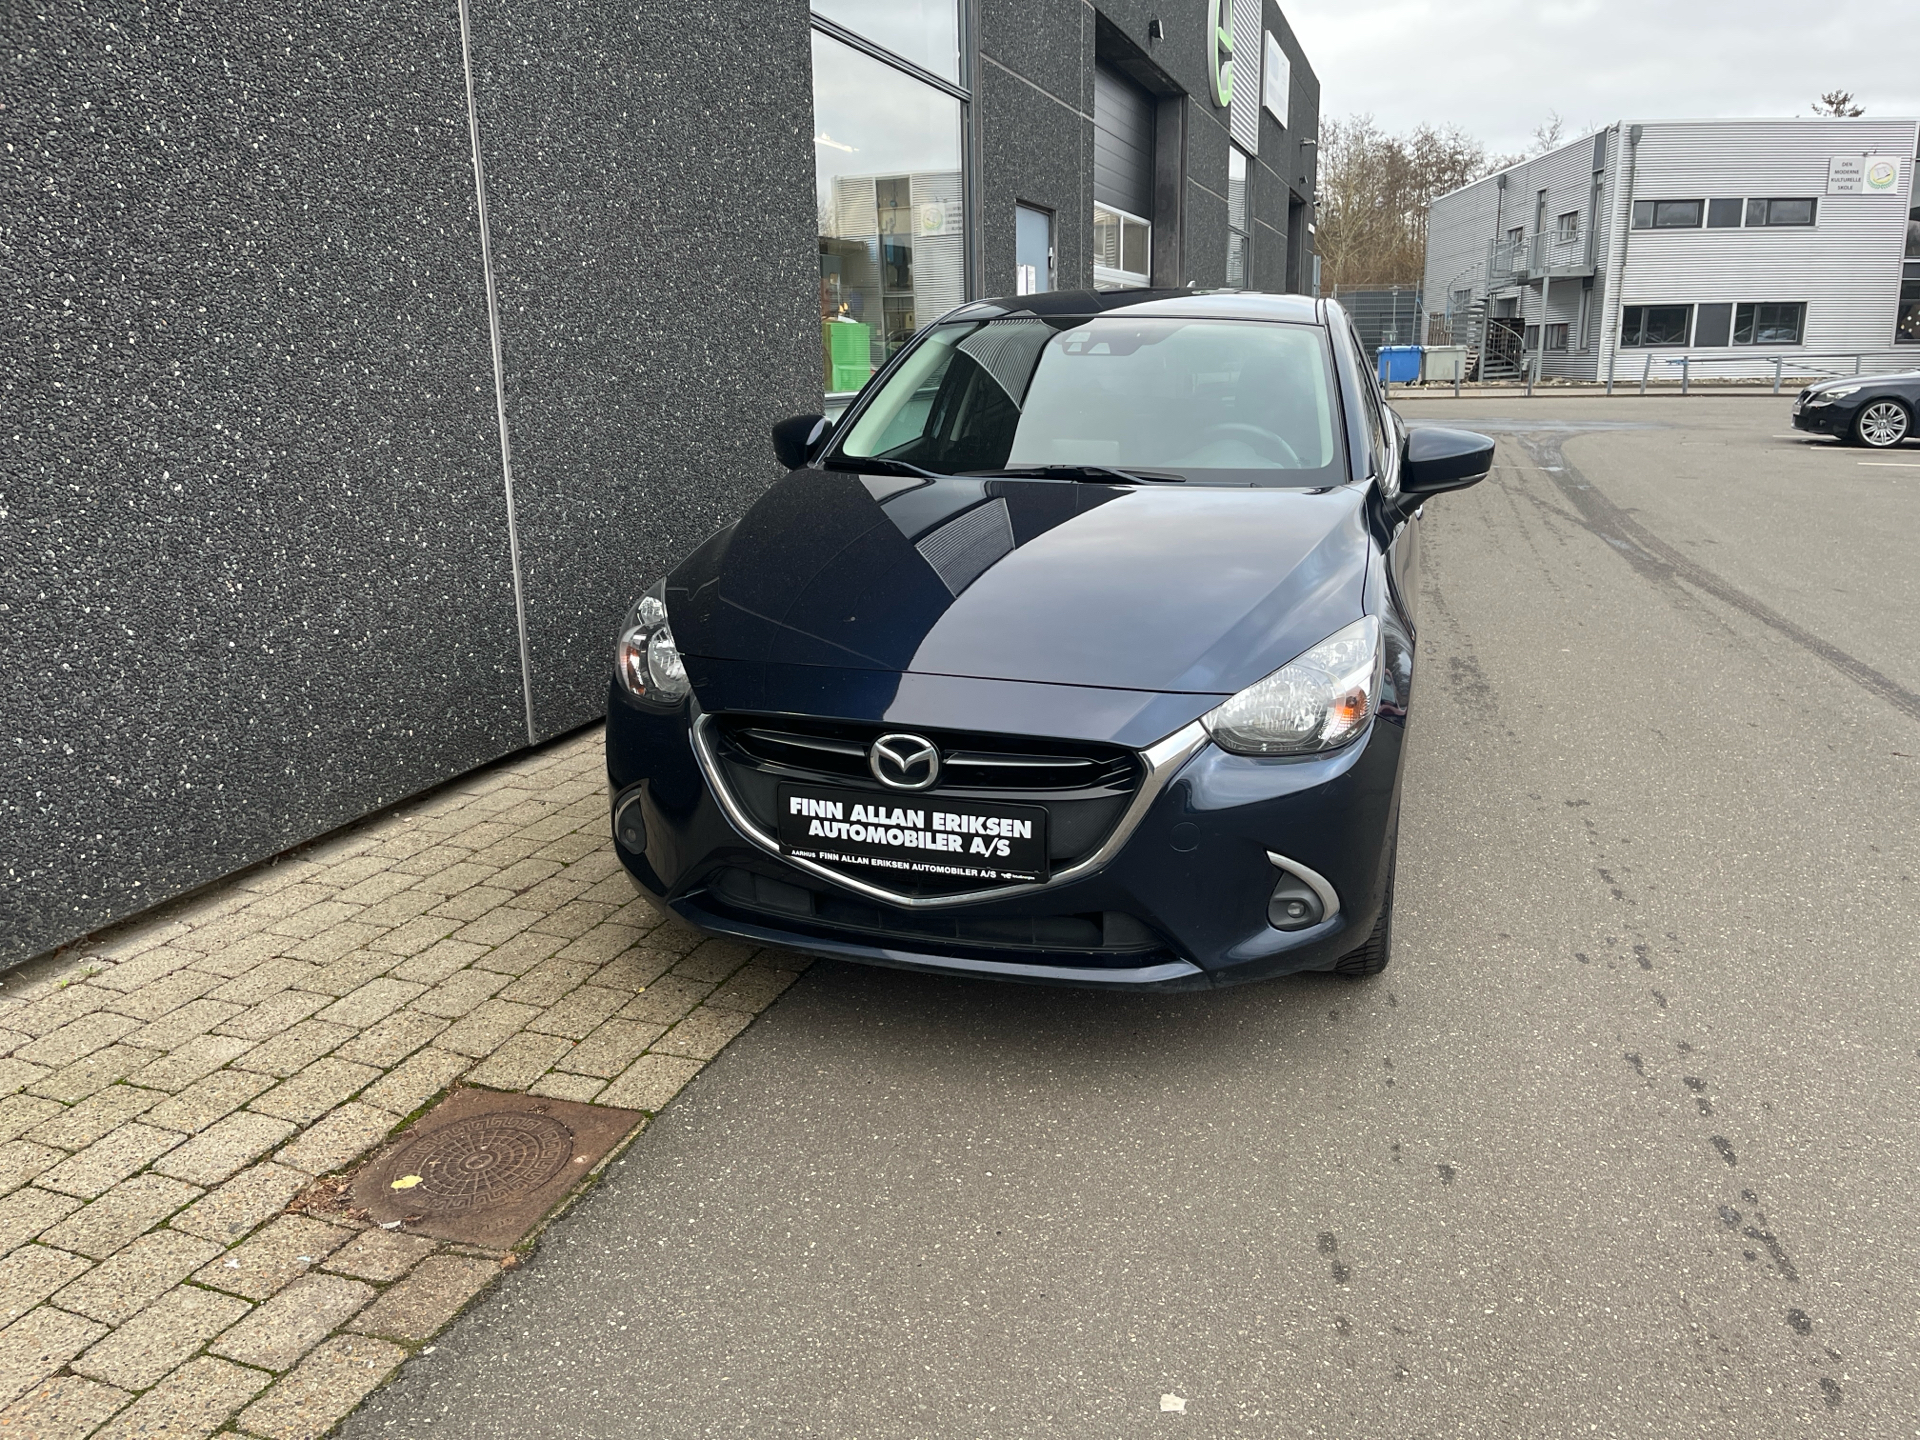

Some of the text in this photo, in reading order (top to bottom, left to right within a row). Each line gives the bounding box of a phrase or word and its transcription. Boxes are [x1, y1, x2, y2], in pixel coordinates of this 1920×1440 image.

[790, 796, 1032, 839] FINN ALLAN ERIKSEN
[808, 819, 1011, 858] AUTOMOBILER A/S
[791, 849, 997, 878] AARHUS FINN ALLAN ERIKSEN AUTOMOBILER A/S
